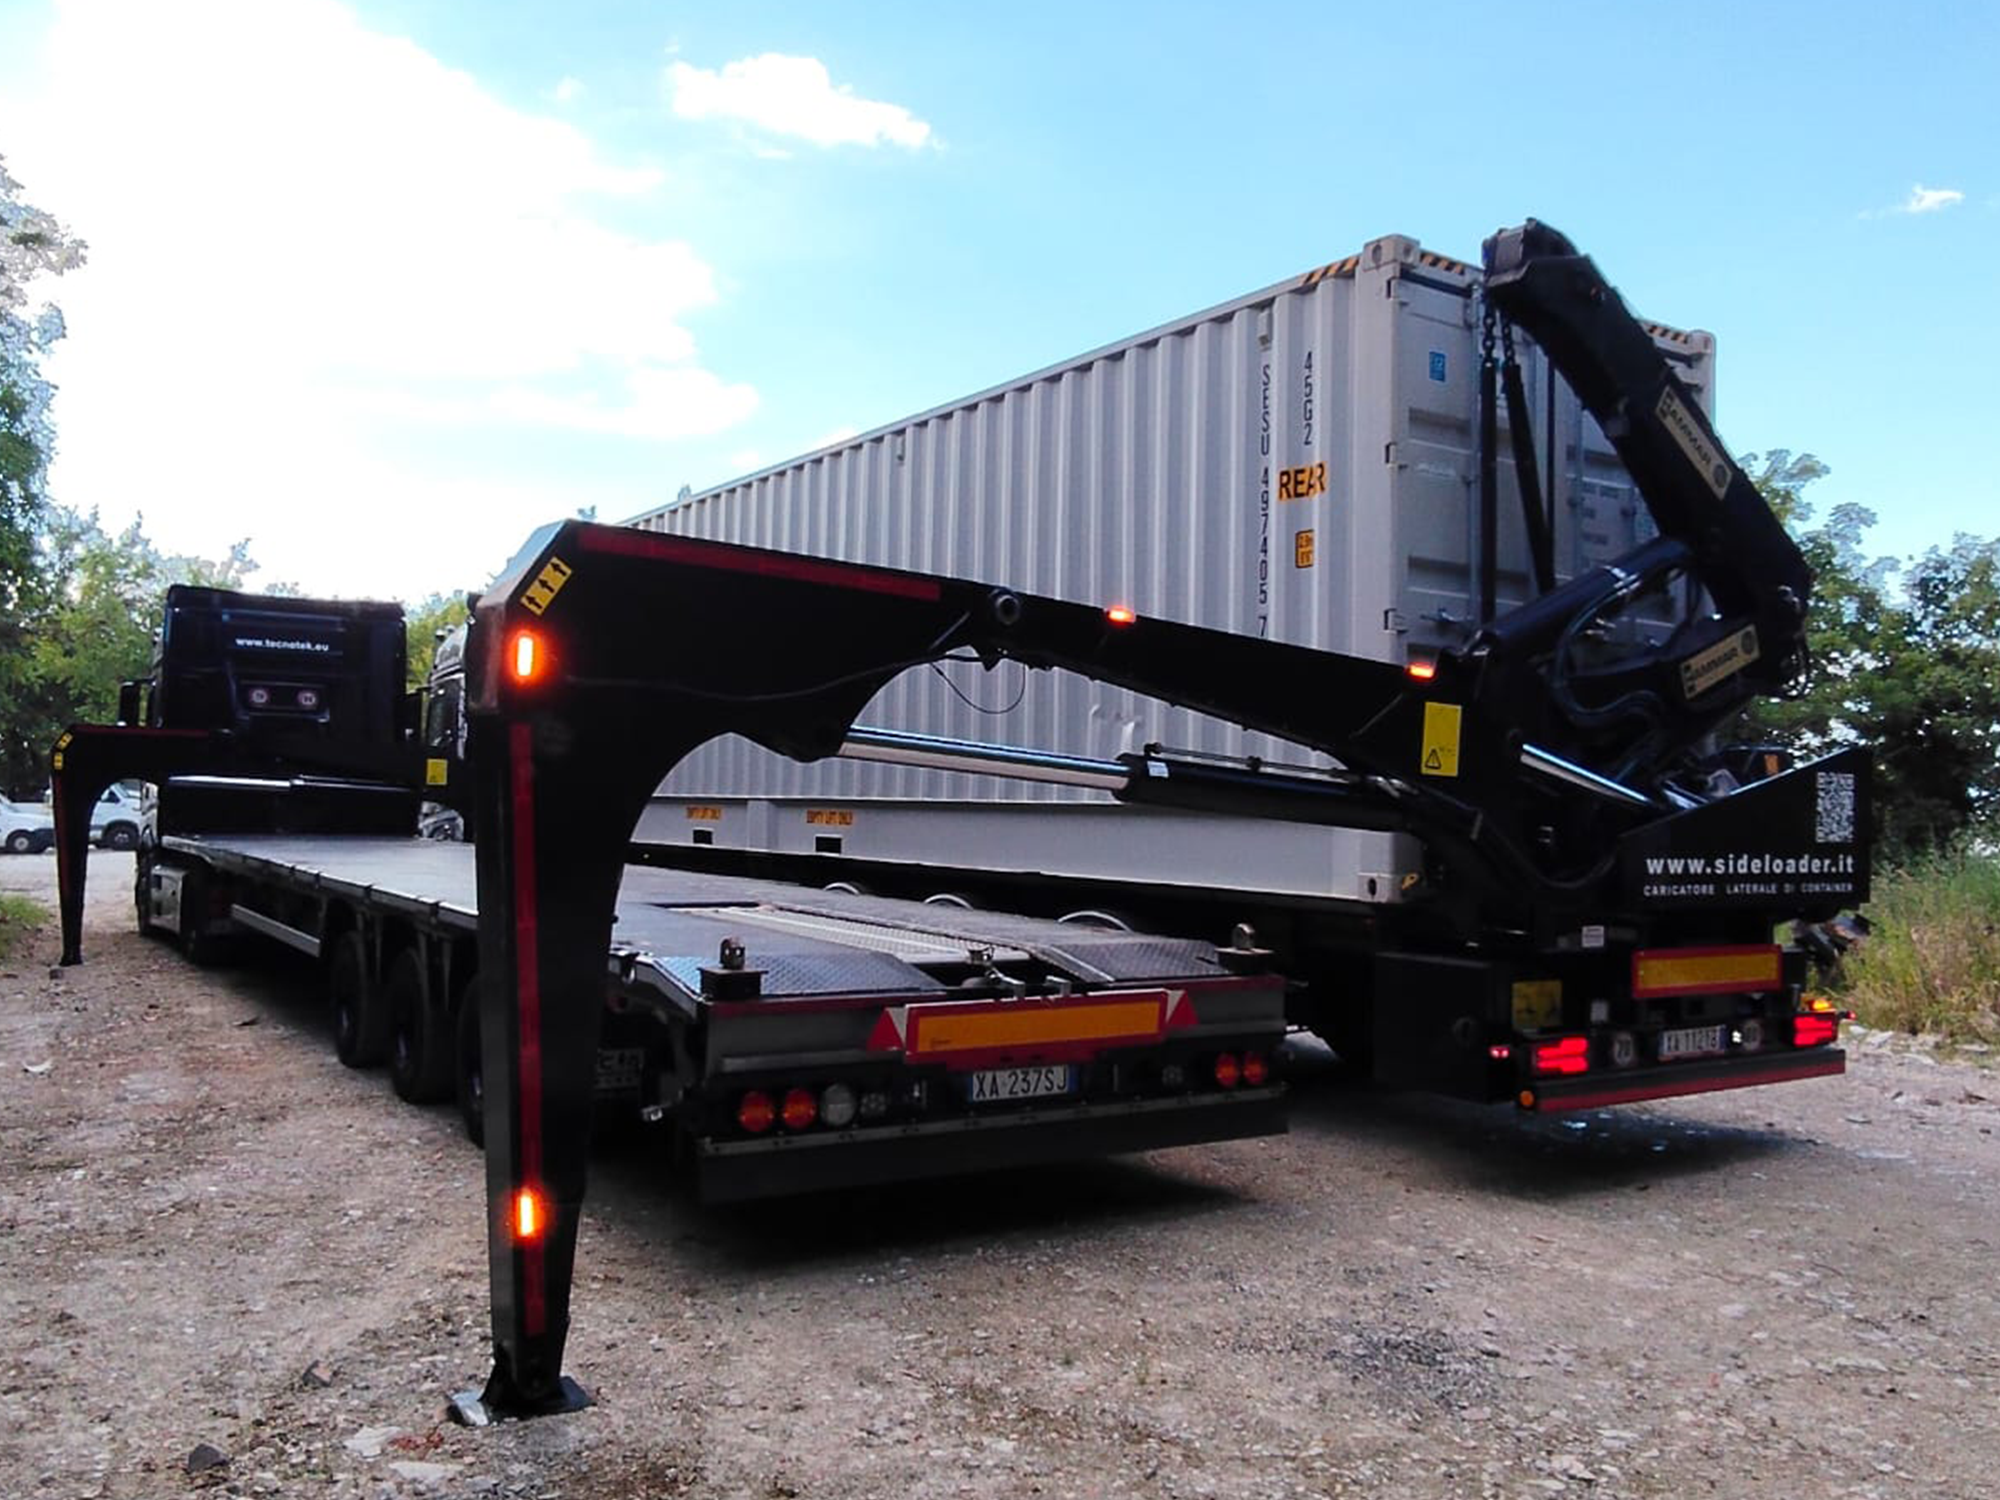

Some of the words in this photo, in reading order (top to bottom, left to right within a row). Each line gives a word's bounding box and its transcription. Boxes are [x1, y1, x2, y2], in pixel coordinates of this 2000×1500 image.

[1261, 363, 1271, 456] SESU
[1303, 350, 1313, 446] 45G2
[1279, 462, 1326, 500] REAR
[1259, 466, 1270, 605] 497405
[1257, 615, 1268, 638] 7
[1646, 853, 1854, 875] www.sideloader.it
[1643, 883, 1715, 897] CARICATORE
[1726, 882, 1777, 895] LATERALE
[1801, 881, 1853, 893] CONTAINER
[975, 1072, 1000, 1099] XA
[1008, 1066, 1067, 1096] 237SJ
